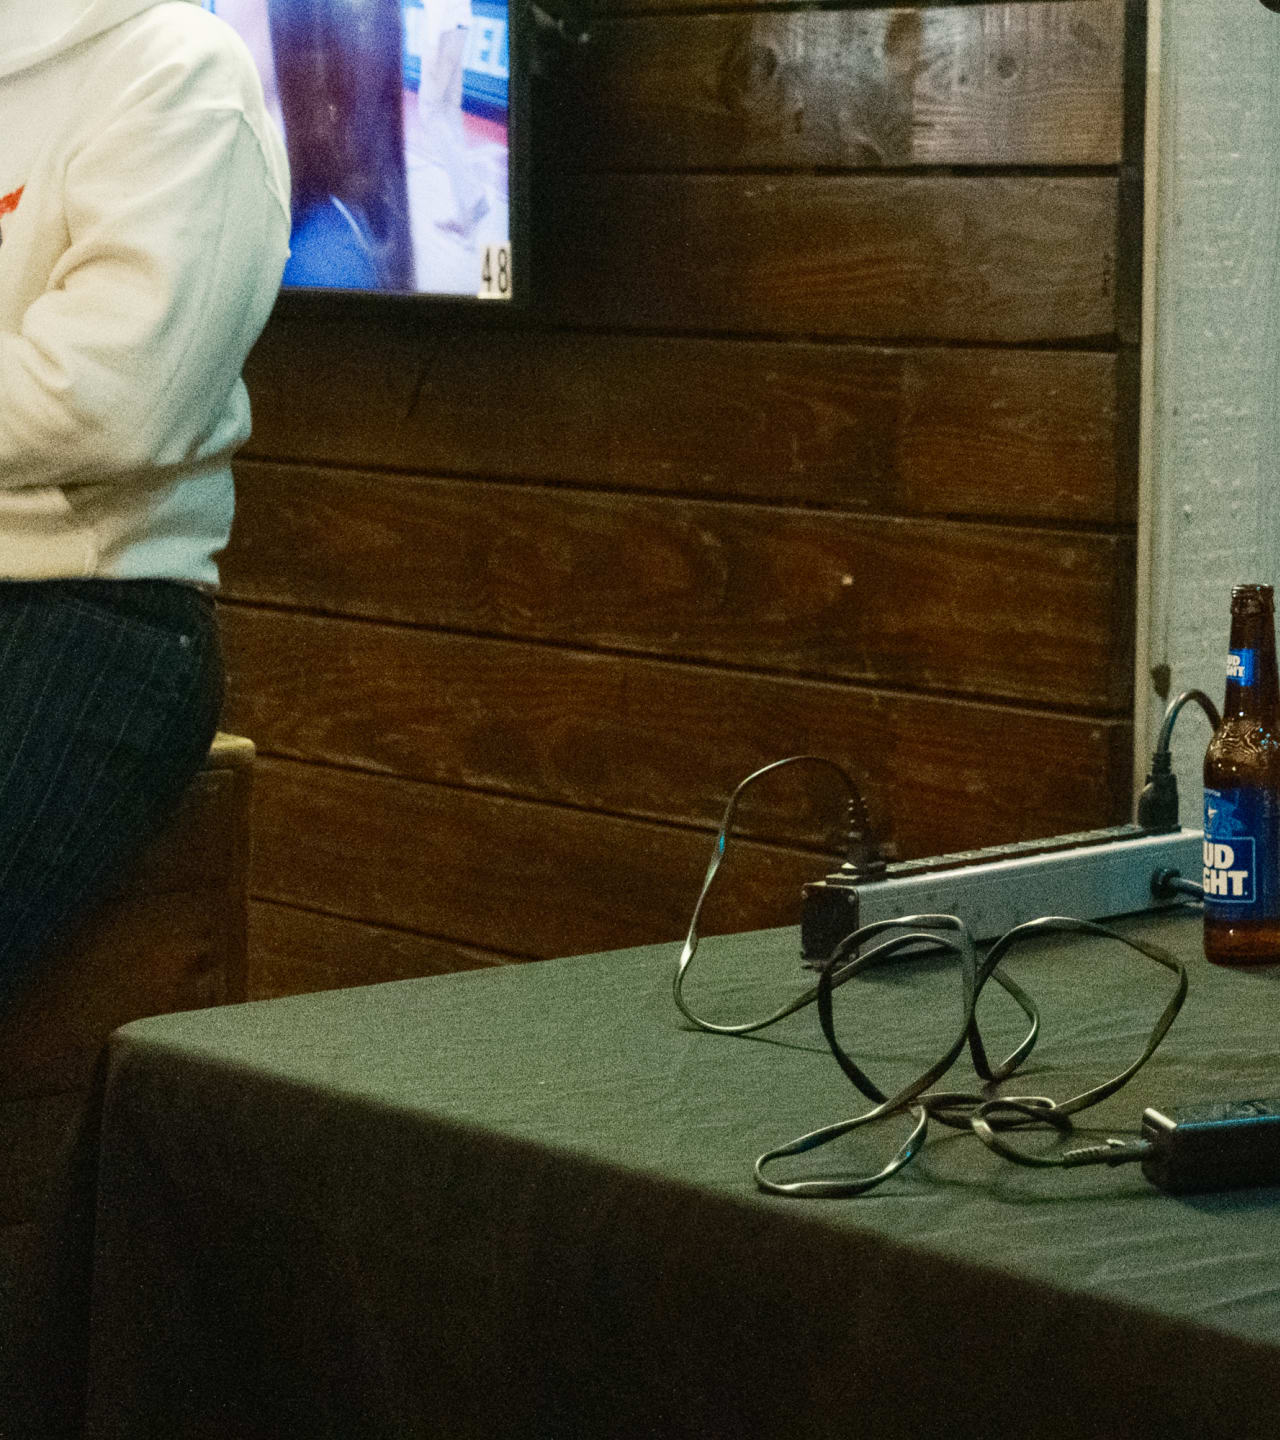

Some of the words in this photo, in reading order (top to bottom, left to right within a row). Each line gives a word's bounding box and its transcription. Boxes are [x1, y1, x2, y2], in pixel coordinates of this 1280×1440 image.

[482, 247, 508, 293] 48
[1203, 841, 1234, 869] UD
[1203, 867, 1248, 896] GHT
